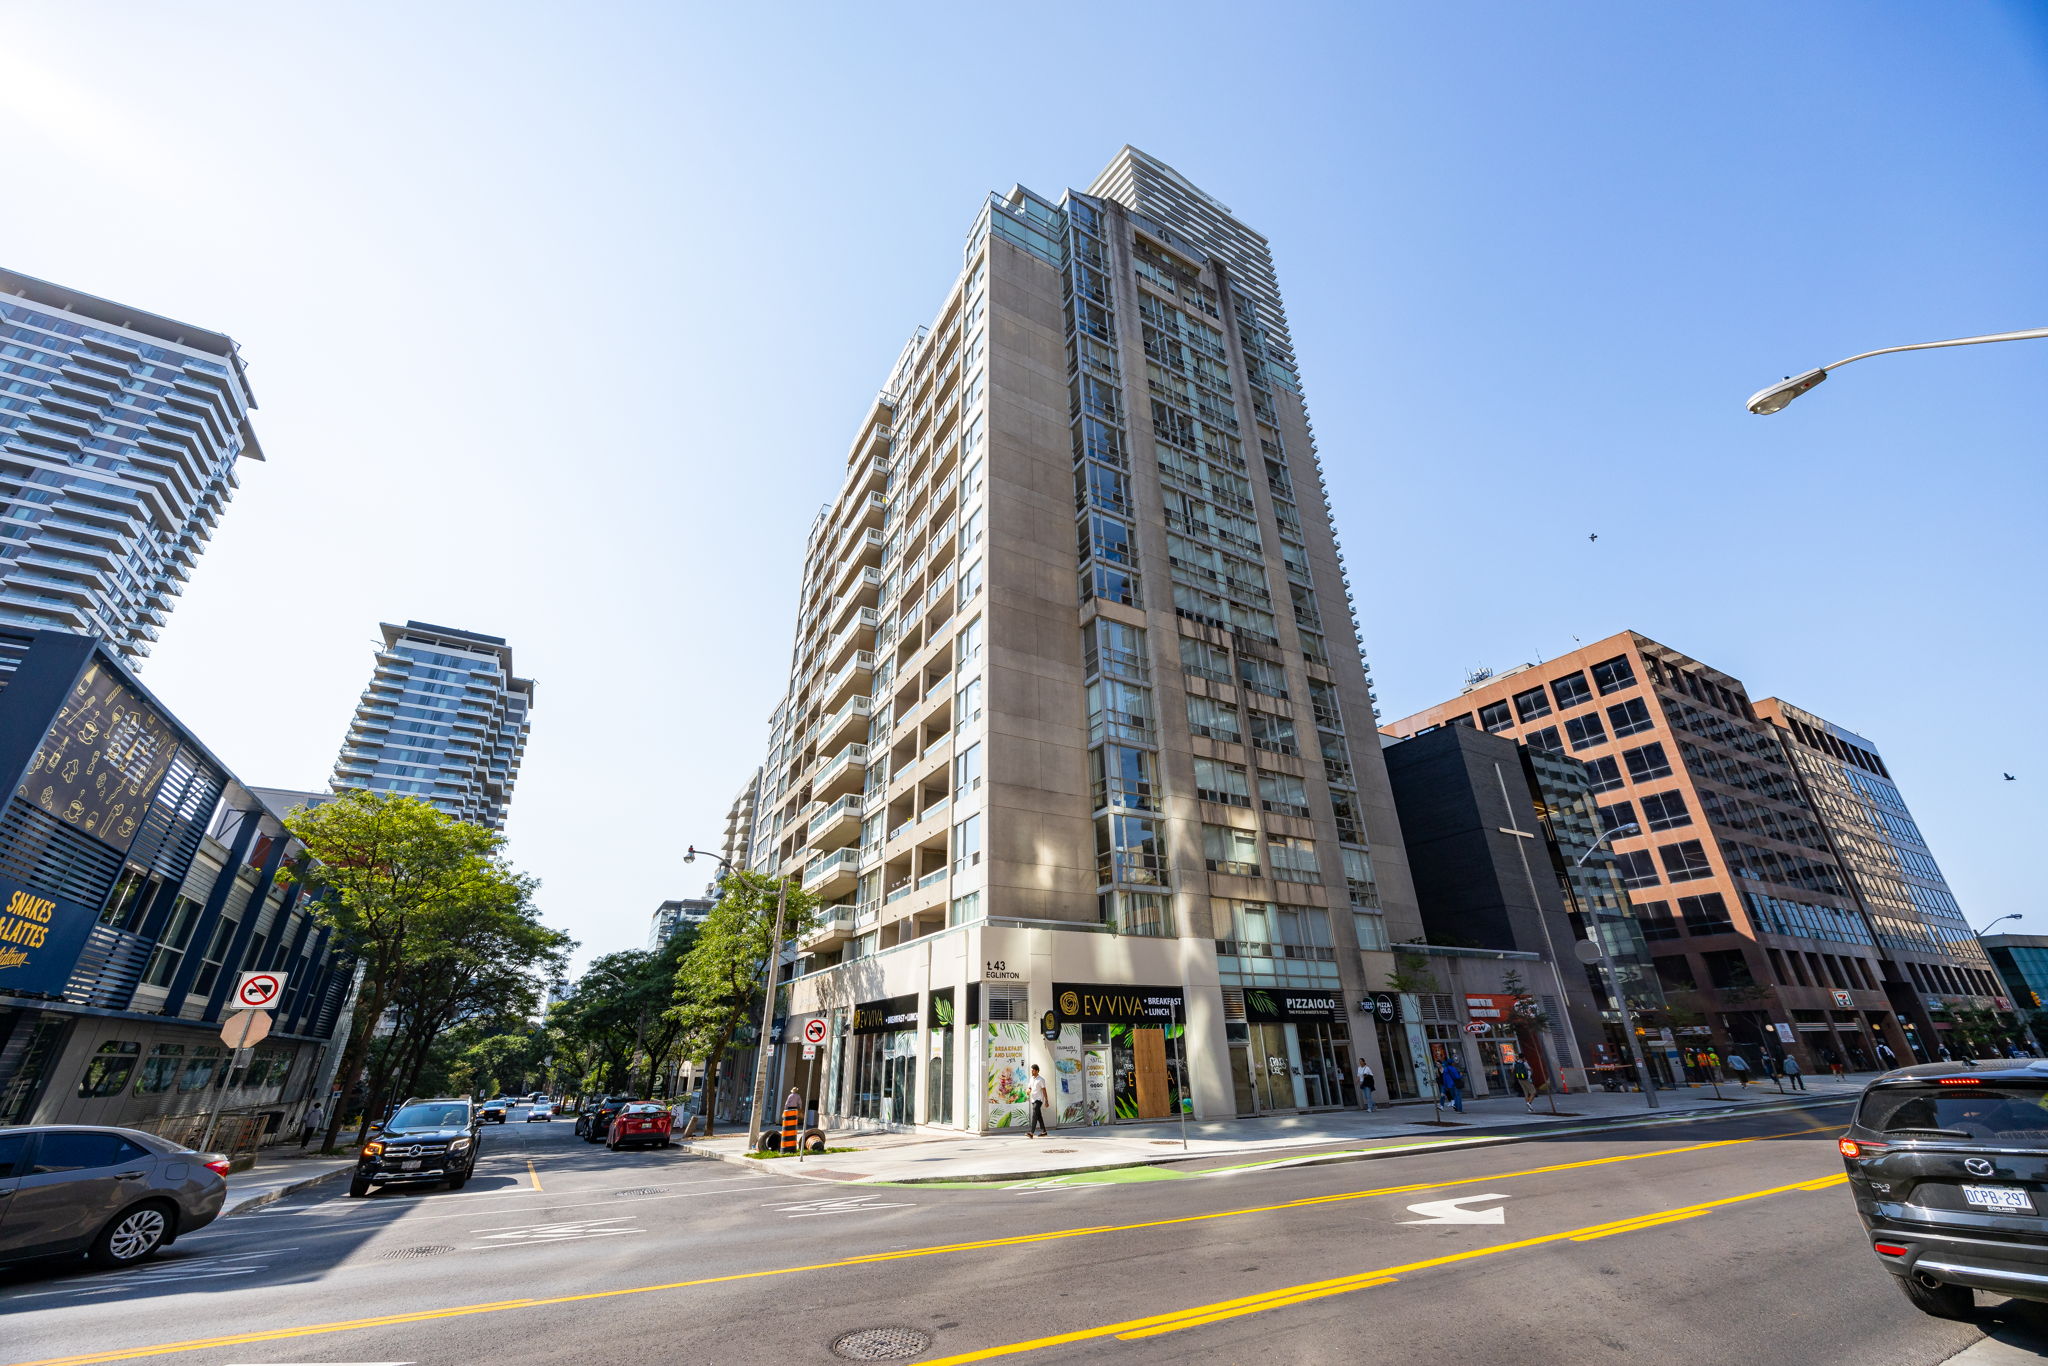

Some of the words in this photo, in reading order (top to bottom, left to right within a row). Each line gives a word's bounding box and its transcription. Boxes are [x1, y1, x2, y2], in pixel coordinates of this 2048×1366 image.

[6, 890, 56, 923] SNAKES
[986, 971, 1020, 979] EGLINTON
[1084, 995, 1145, 1016] EVVIVA
[1147, 998, 1182, 1006] BREAKFAST
[1286, 998, 1335, 1009] PIZZAIOLO
[1148, 1008, 1170, 1016] LUNCH
[1965, 1190, 1999, 1204] DCPB
[2003, 1192, 2028, 1206] 297
